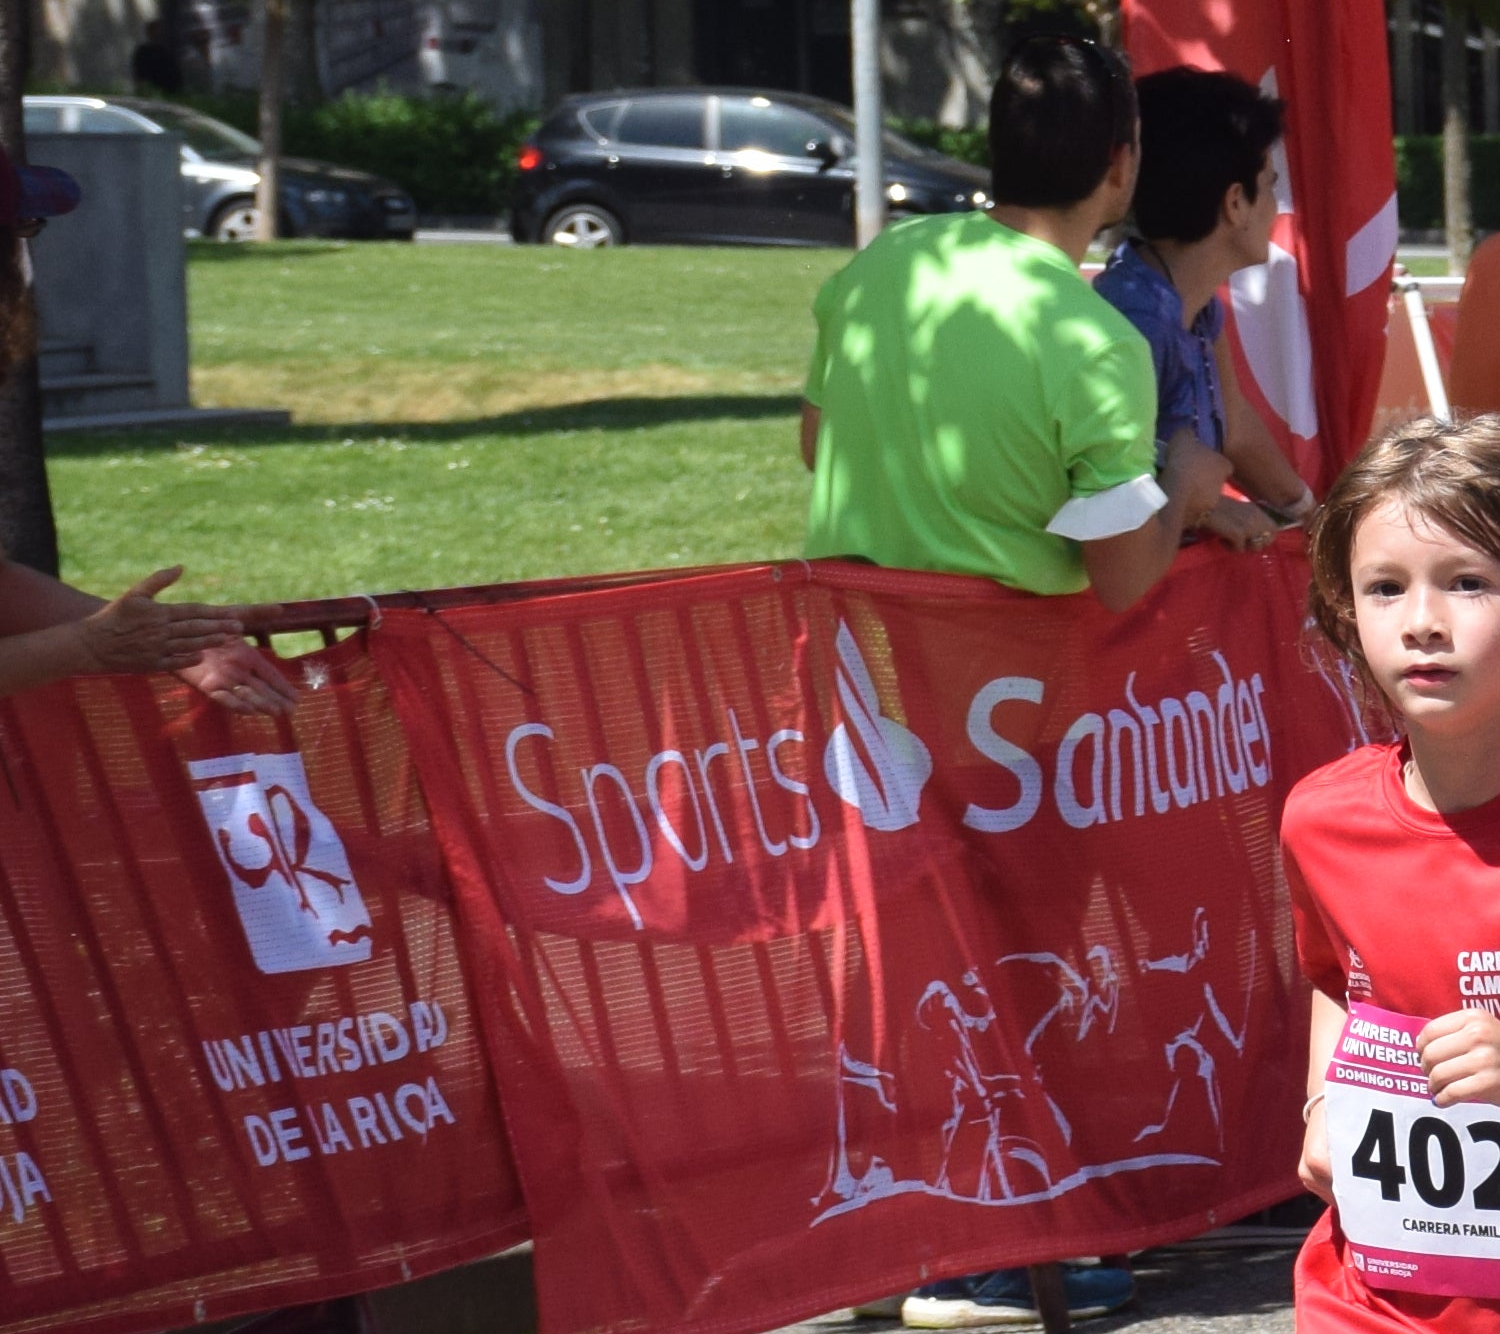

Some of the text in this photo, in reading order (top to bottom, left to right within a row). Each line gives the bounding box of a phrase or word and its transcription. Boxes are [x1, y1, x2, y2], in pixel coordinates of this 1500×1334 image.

[505, 651, 1273, 930] Sports Santander
[202, 1001, 449, 1093] UNIVERSIDAD
[1349, 1019, 1413, 1048] CARRERA
[1335, 1067, 1428, 1094] DOMINGO 15 DE
[245, 1107, 312, 1167] DE
[1403, 1218, 1461, 1235] CARRERA
